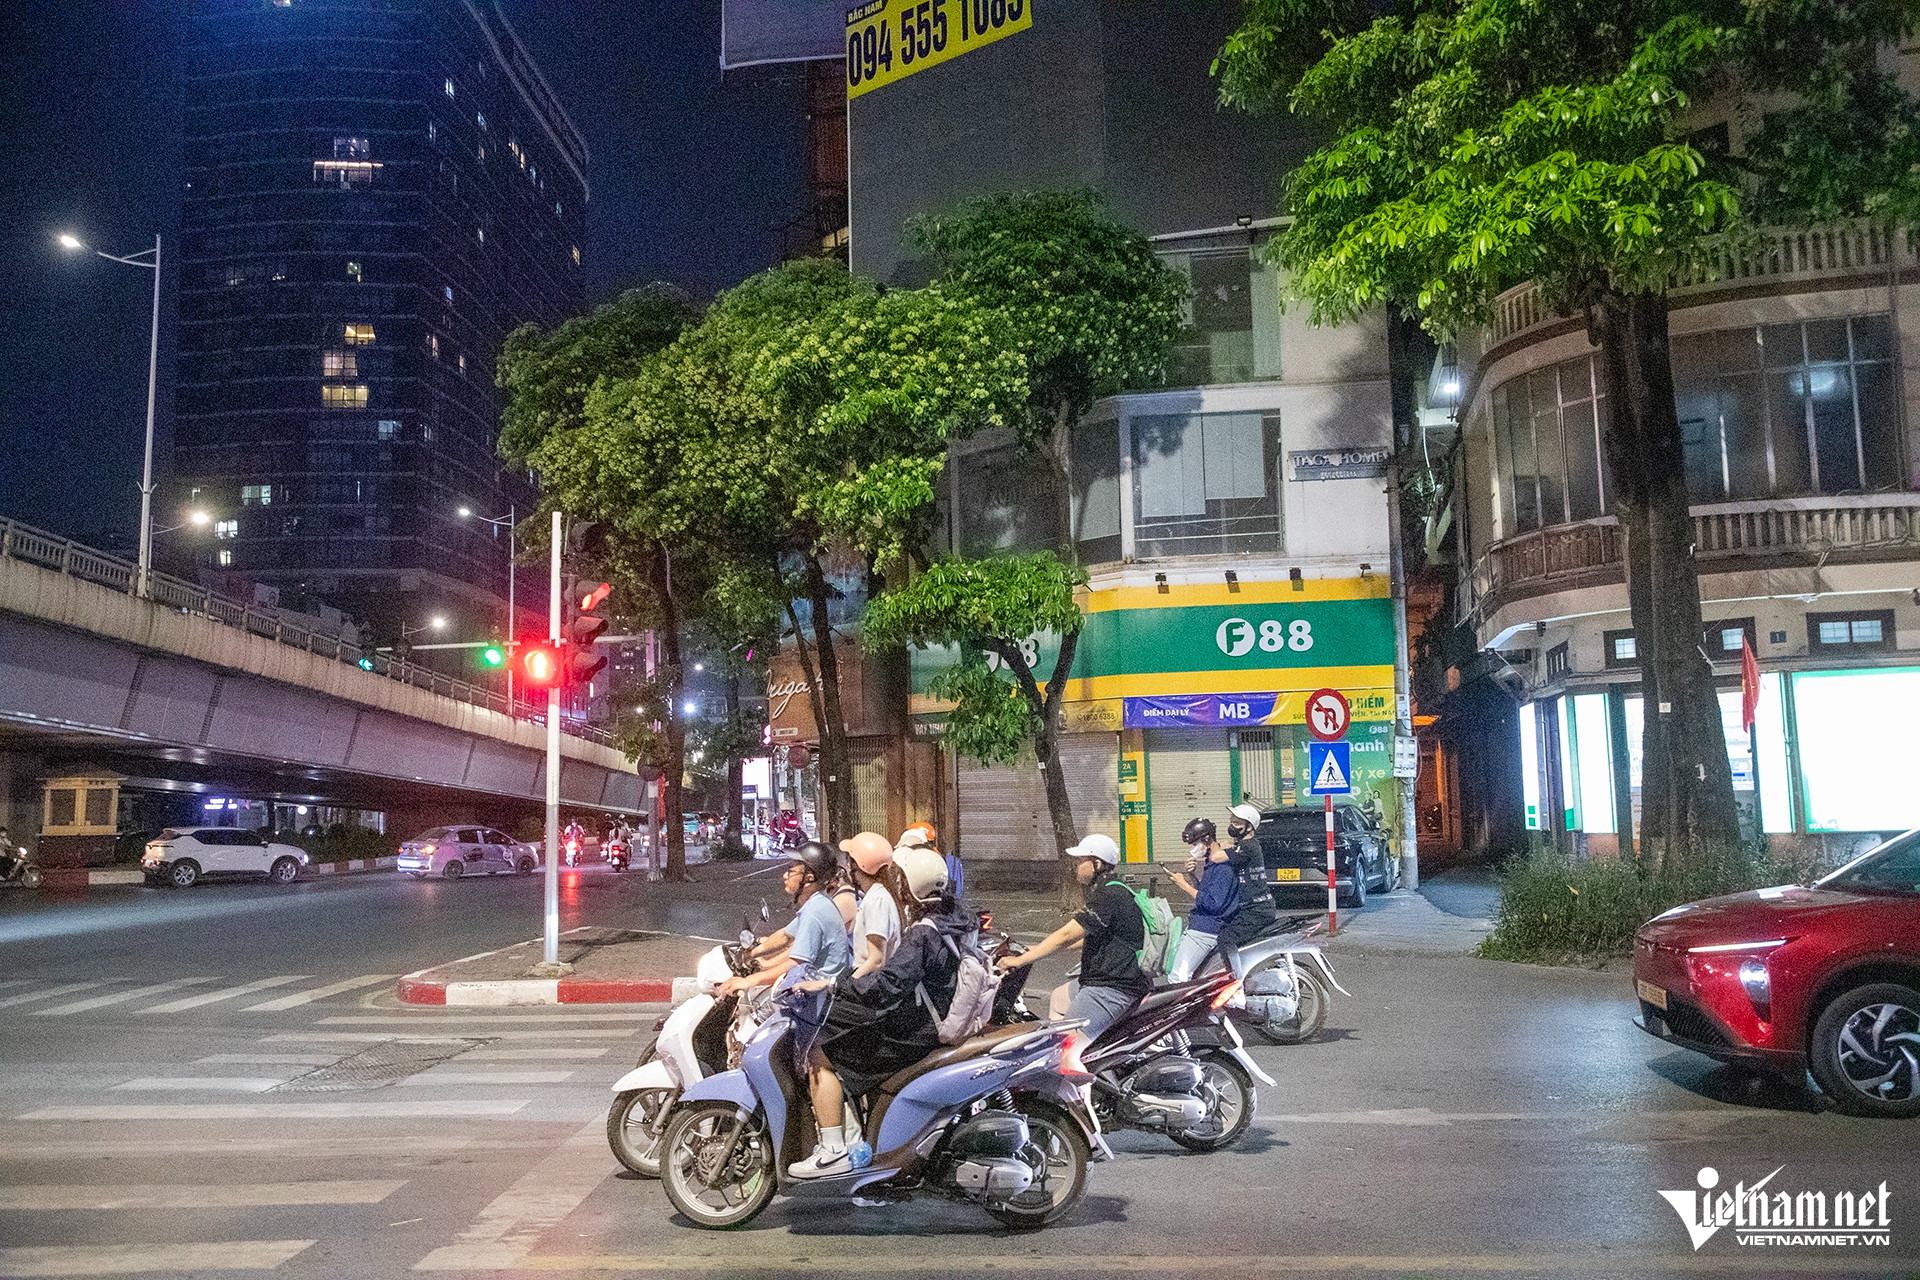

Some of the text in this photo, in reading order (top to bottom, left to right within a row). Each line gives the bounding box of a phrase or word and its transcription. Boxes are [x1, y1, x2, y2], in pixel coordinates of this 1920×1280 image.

[849, 19, 893, 87] 094
[901, 0, 948, 65] 555
[1216, 618, 1314, 656] F88
[1219, 703, 1250, 719] MB
[1368, 769, 1386, 779] xe
